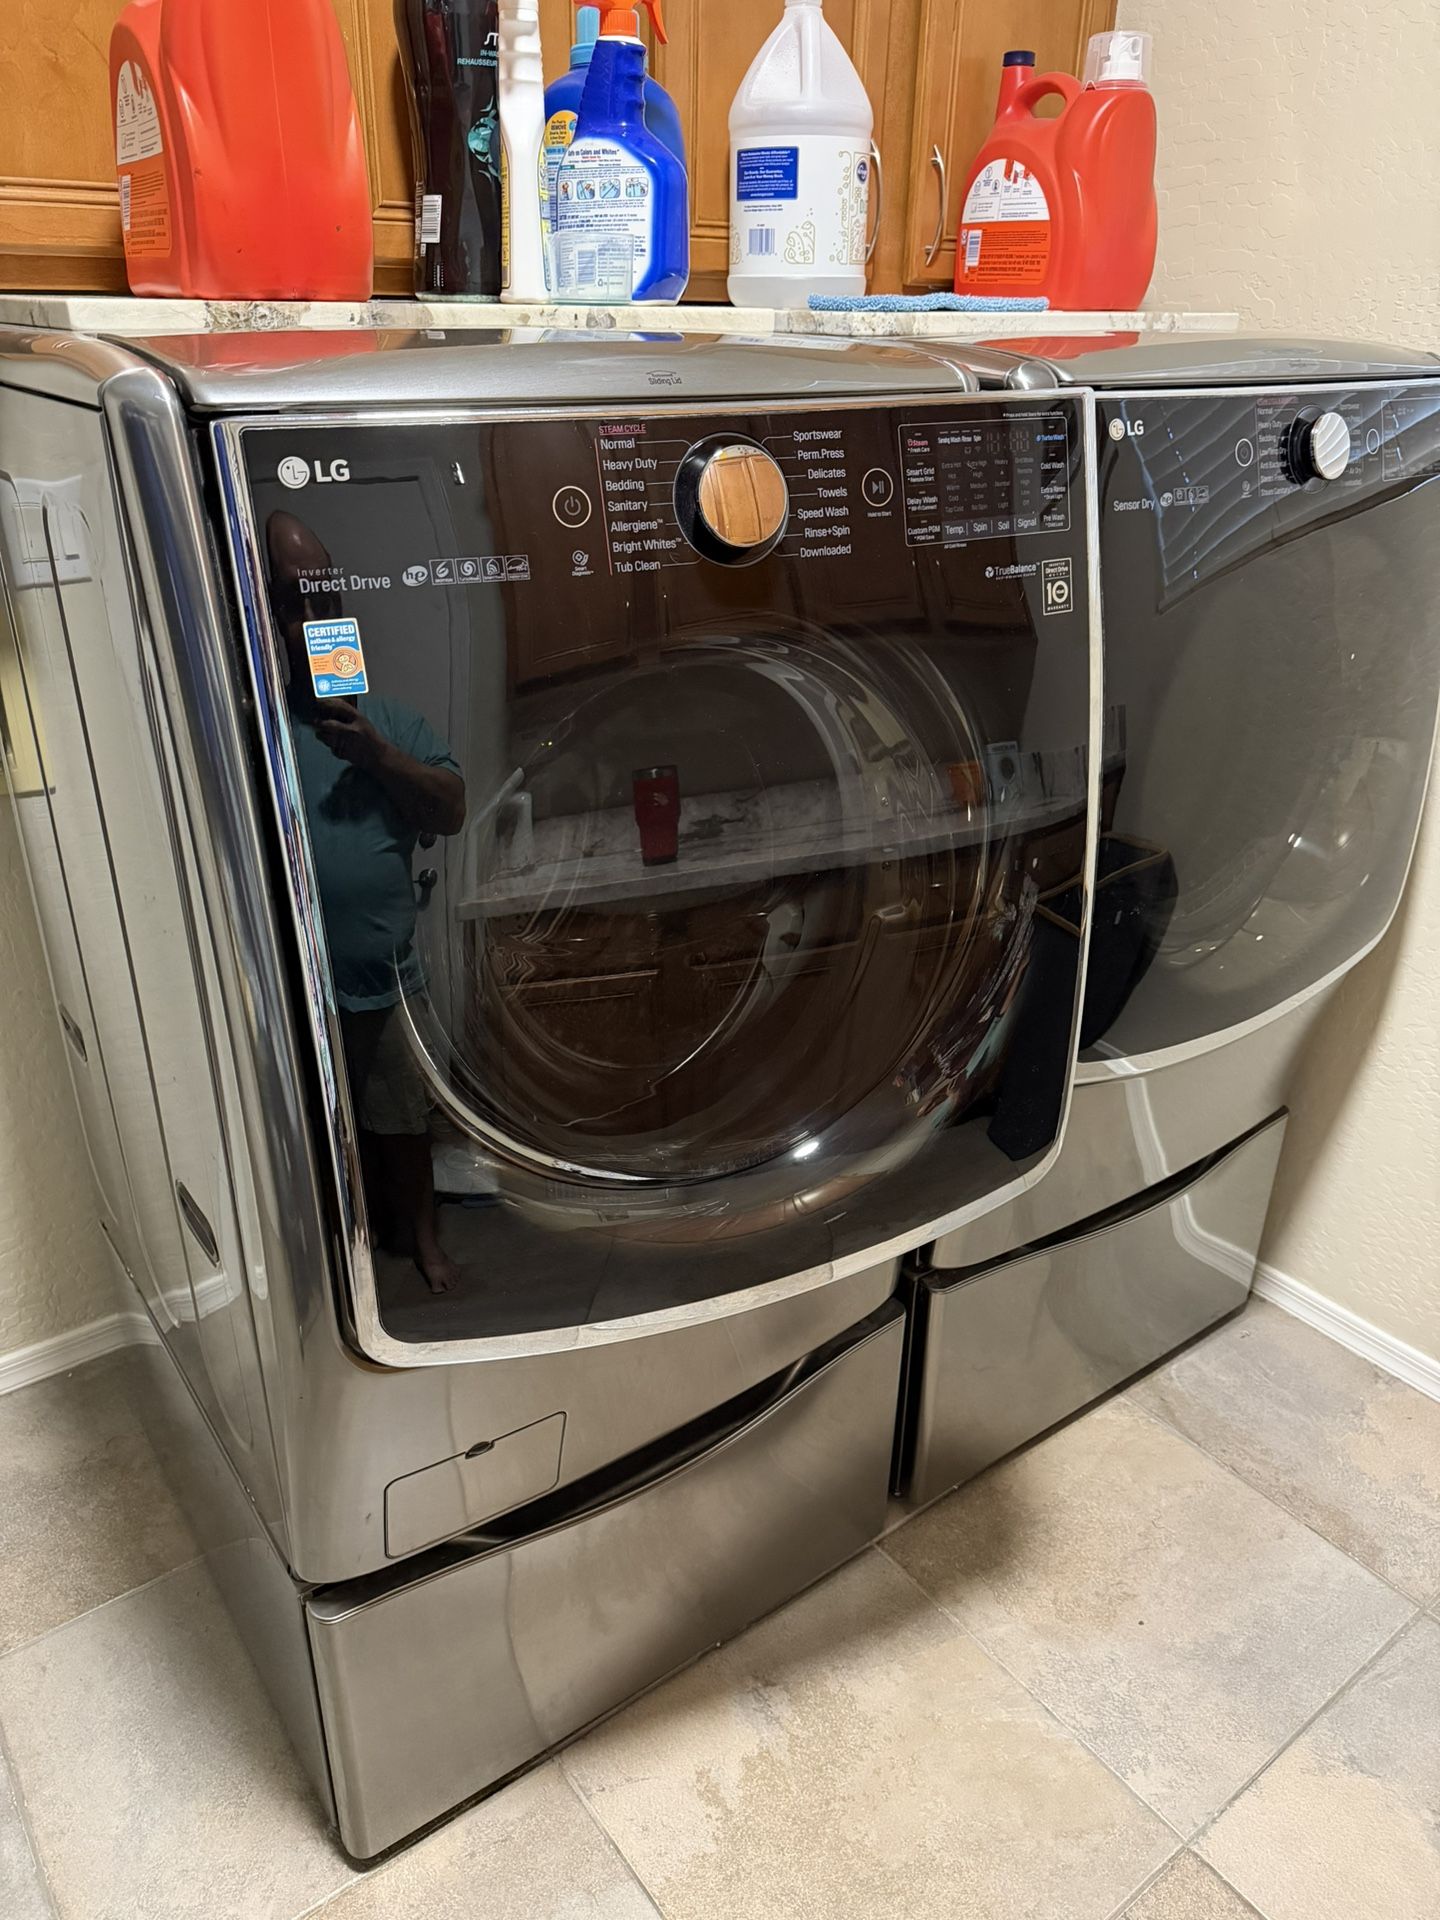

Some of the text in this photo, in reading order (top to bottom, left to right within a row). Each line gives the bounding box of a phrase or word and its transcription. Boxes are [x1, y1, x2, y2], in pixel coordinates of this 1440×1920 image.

[648, 377, 672, 386] Sliding
[599, 423, 647, 435] STEAM CYCLE
[1127, 419, 1144, 436] LG
[793, 429, 843, 443] Sportswear
[600, 438, 635, 450] Normal
[603, 457, 657, 471] Heavy Duty
[314, 459, 350, 482] LG
[808, 468, 846, 479] Delicates
[906, 467, 935, 476] Smart Grid
[606, 479, 645, 492] Bedding
[817, 486, 848, 498] Towels
[608, 500, 648, 512] Sanitary
[906, 497, 922, 505] Delay
[1113, 498, 1155, 511] Sensor Dry
[797, 506, 849, 520] Speed Wash
[973, 522, 988, 533] Spin
[998, 520, 1010, 531] Soil
[1017, 517, 1036, 529] Signal
[804, 525, 850, 538] Rinse+Spin
[908, 525, 940, 535] Custom PGM
[945, 525, 965, 535] Temp.
[613, 540, 642, 554] Bright
[800, 544, 852, 558] Downloaded
[297, 567, 344, 577] Inverter
[615, 560, 661, 573] Tub Clean
[300, 573, 391, 594] Direct Drive
[1046, 580, 1069, 605] 10
[308, 624, 355, 638] CERTIFIED
